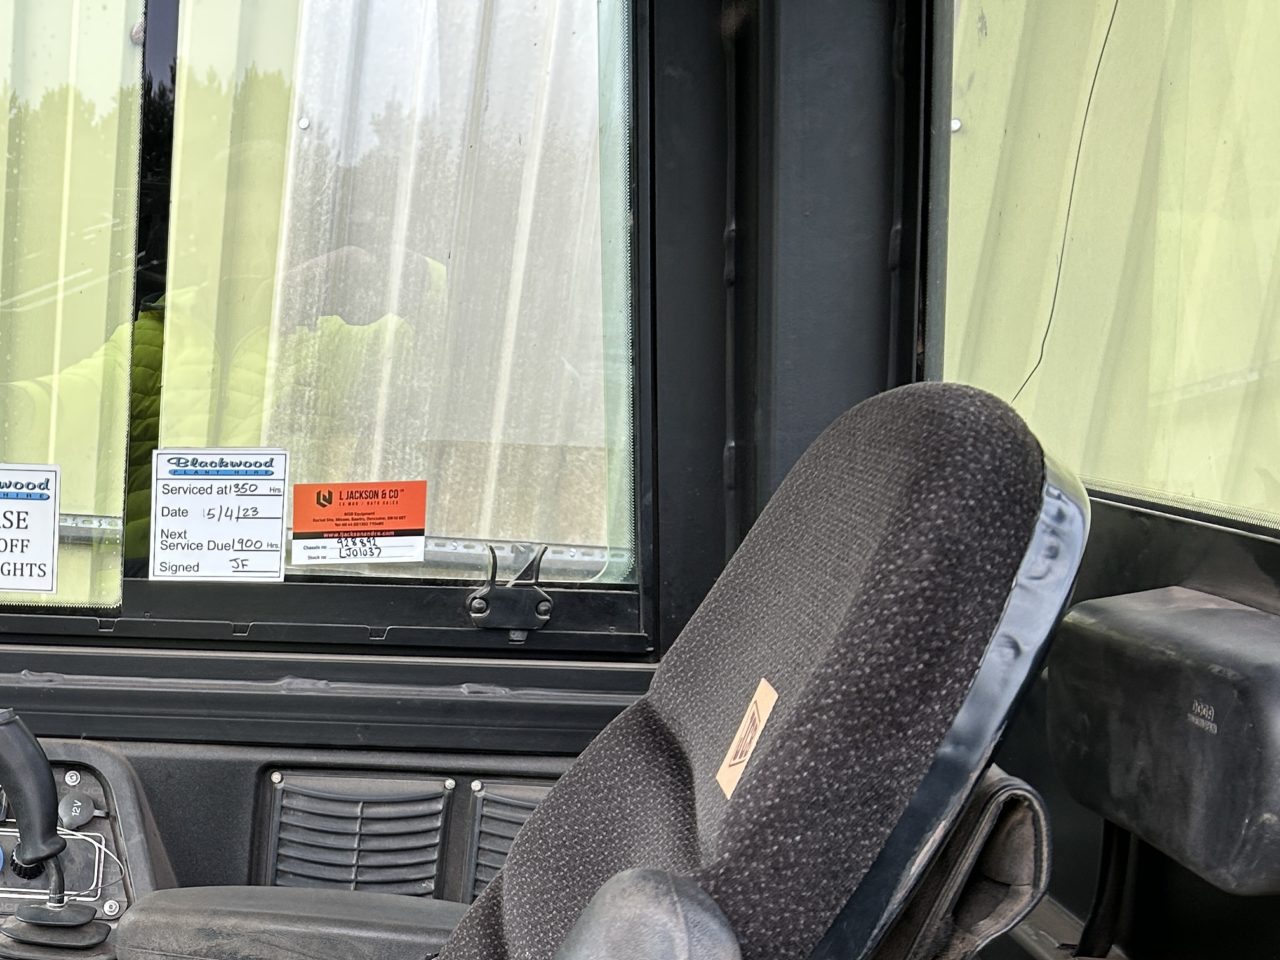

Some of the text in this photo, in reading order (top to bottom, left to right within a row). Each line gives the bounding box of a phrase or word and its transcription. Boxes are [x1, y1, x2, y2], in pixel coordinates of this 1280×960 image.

[167, 457, 274, 468] Blackwood
[161, 483, 213, 495] Serviced
[216, 485, 228, 495] at
[339, 489, 399, 501] L JACKSON & CO
[161, 506, 189, 518] Date
[160, 529, 188, 540] Next
[160, 540, 204, 551] Service
[207, 540, 232, 551] Due
[159, 562, 200, 575] Signed
[71, 799, 82, 817] 12V
